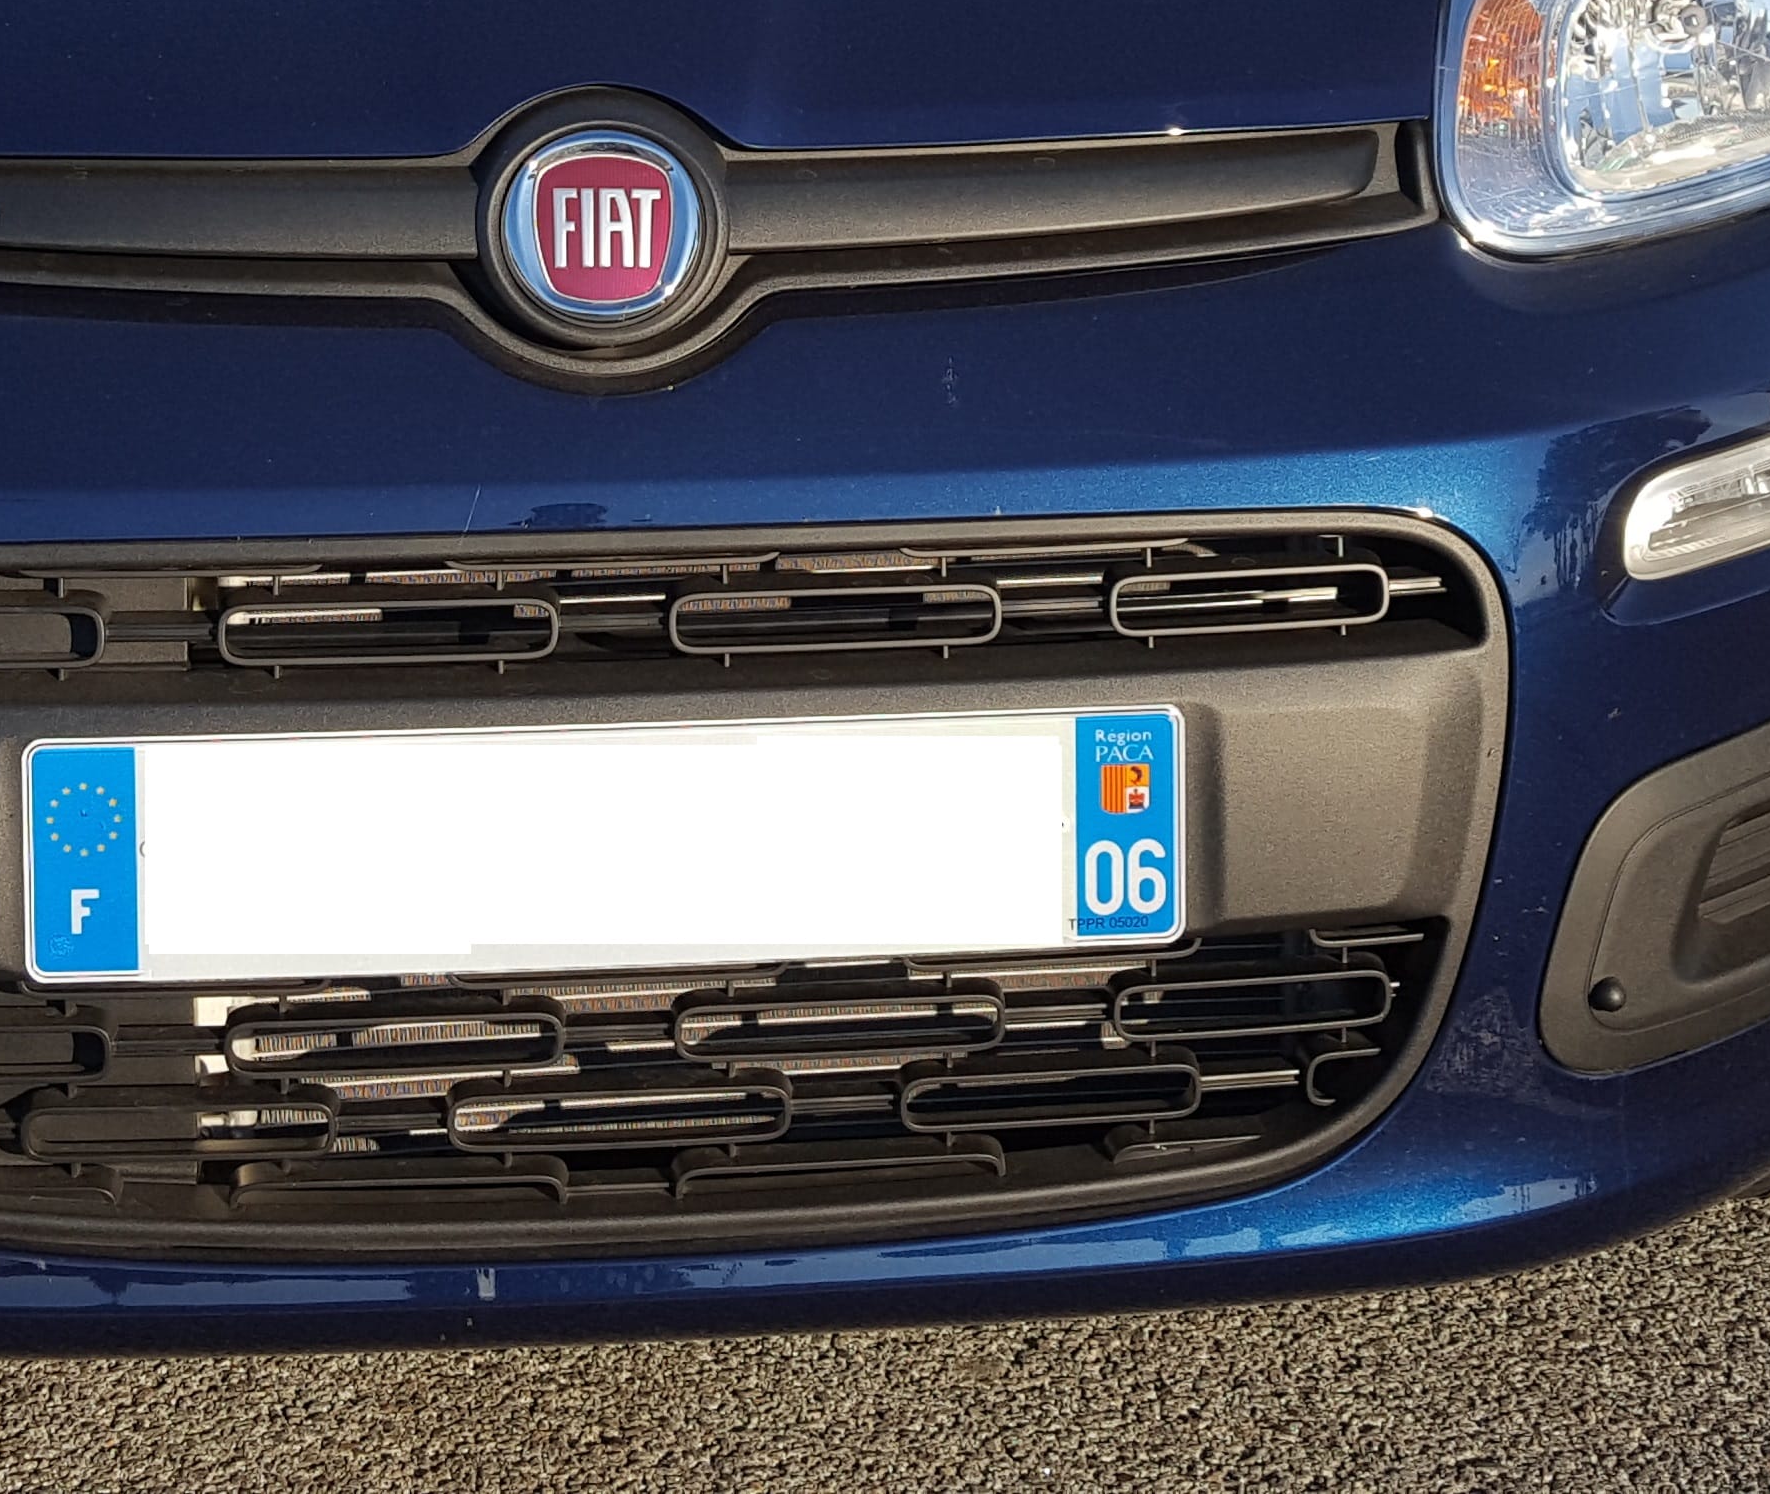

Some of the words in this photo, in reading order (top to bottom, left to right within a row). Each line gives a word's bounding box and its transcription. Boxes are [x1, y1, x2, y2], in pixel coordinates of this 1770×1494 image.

[551, 187, 663, 269] FIAT
[1094, 728, 1154, 746] Région
[1094, 744, 1155, 762] PACA
[1084, 838, 1167, 916] 06
[70, 889, 100, 935] F
[1068, 917, 1105, 931] TPPR
[1108, 915, 1149, 929] 05020
